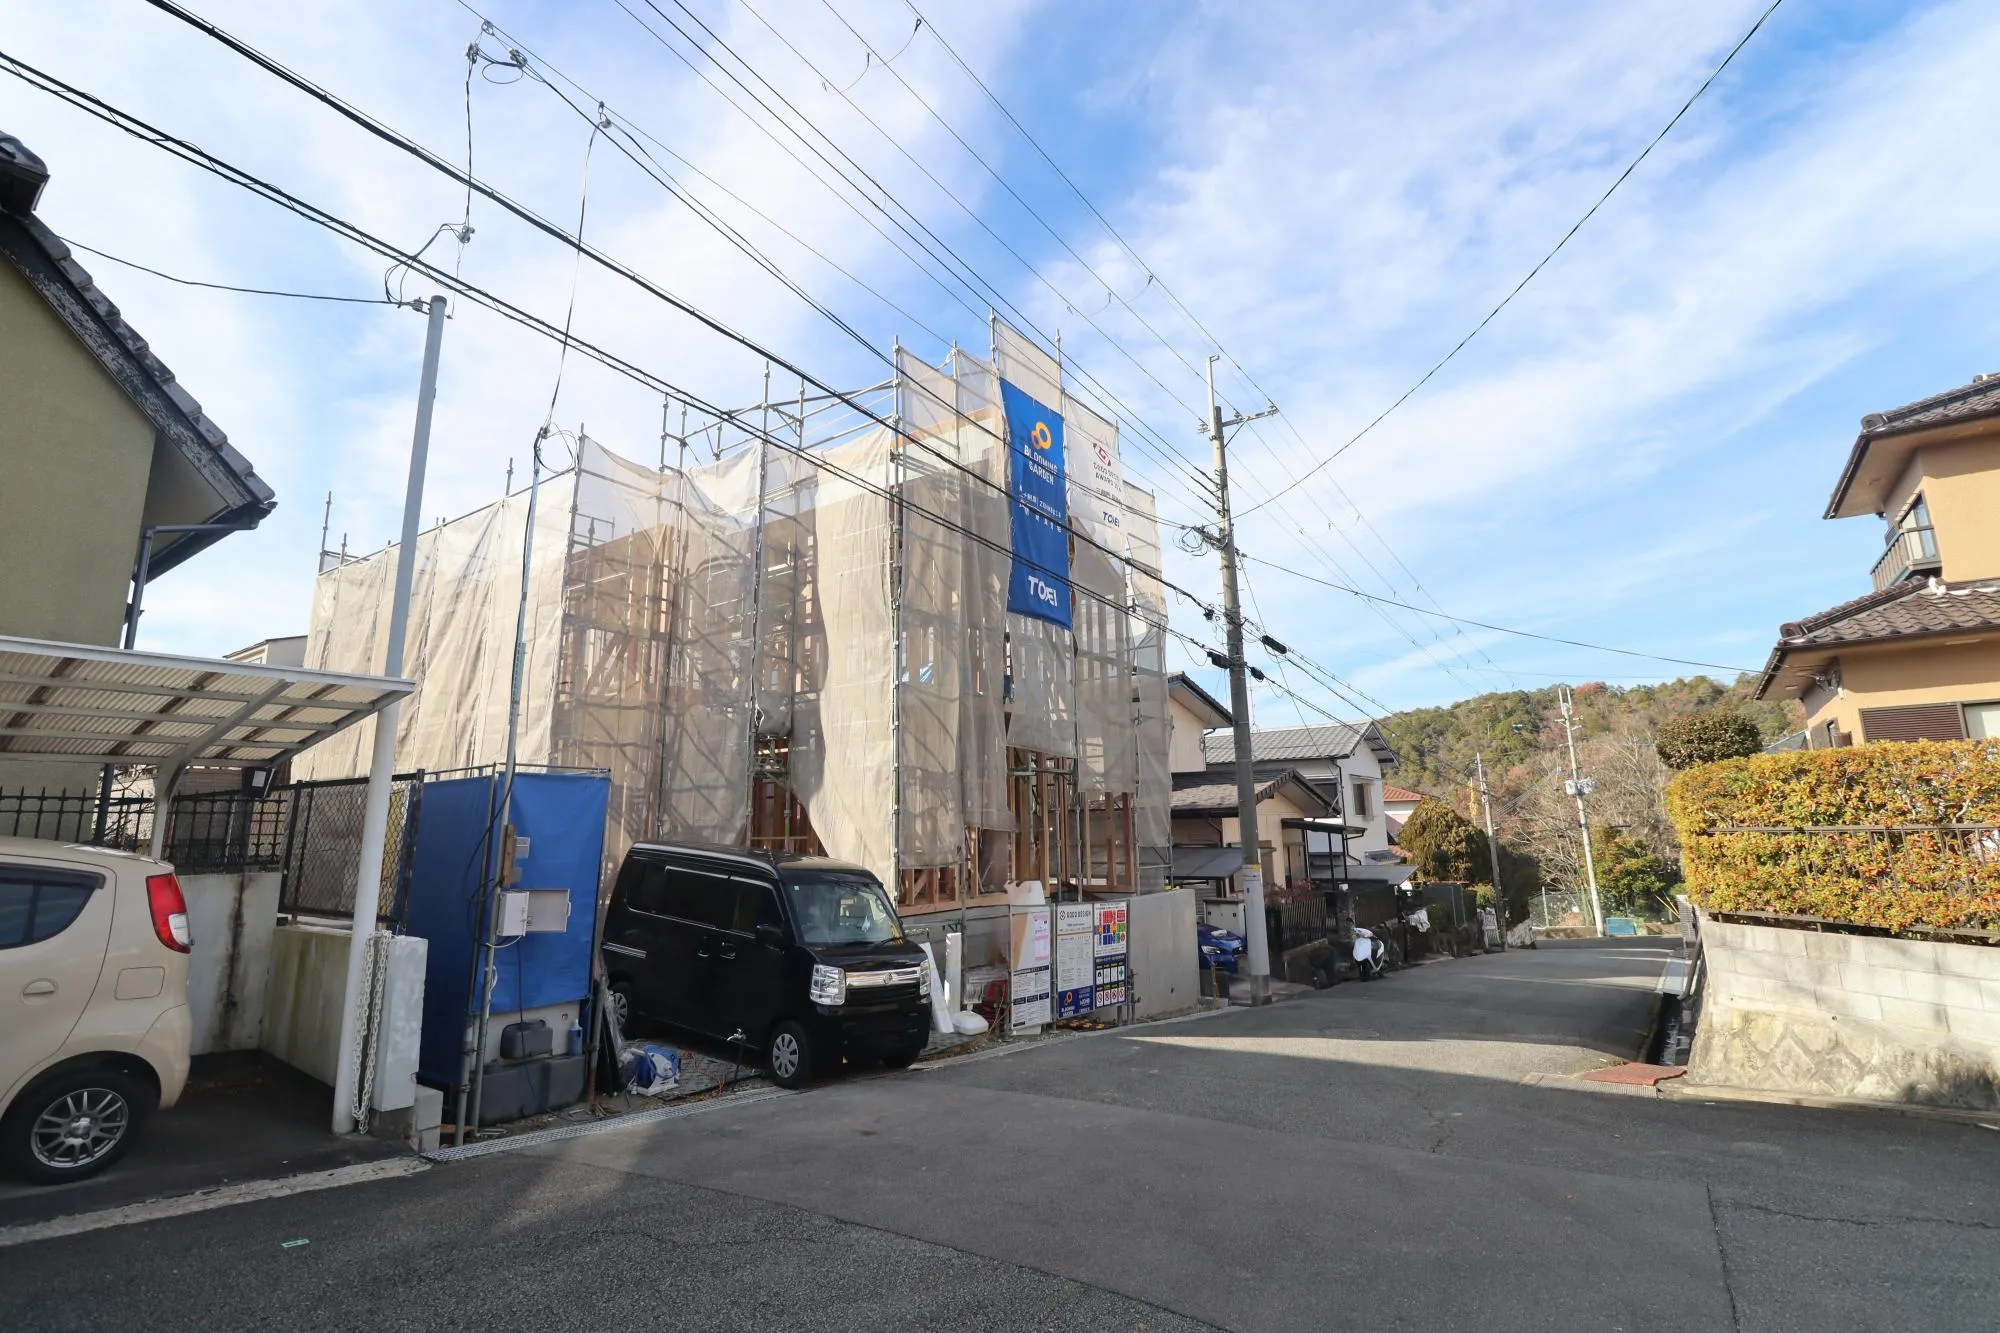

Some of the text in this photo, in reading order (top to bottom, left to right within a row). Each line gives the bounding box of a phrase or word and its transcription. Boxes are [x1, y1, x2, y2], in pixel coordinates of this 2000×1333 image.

[1024, 444, 1058, 474] BLOOMING
[1028, 460, 1054, 485] GARDEN
[1103, 511, 1120, 528] TOEI
[1028, 575, 1058, 607] TOEI
